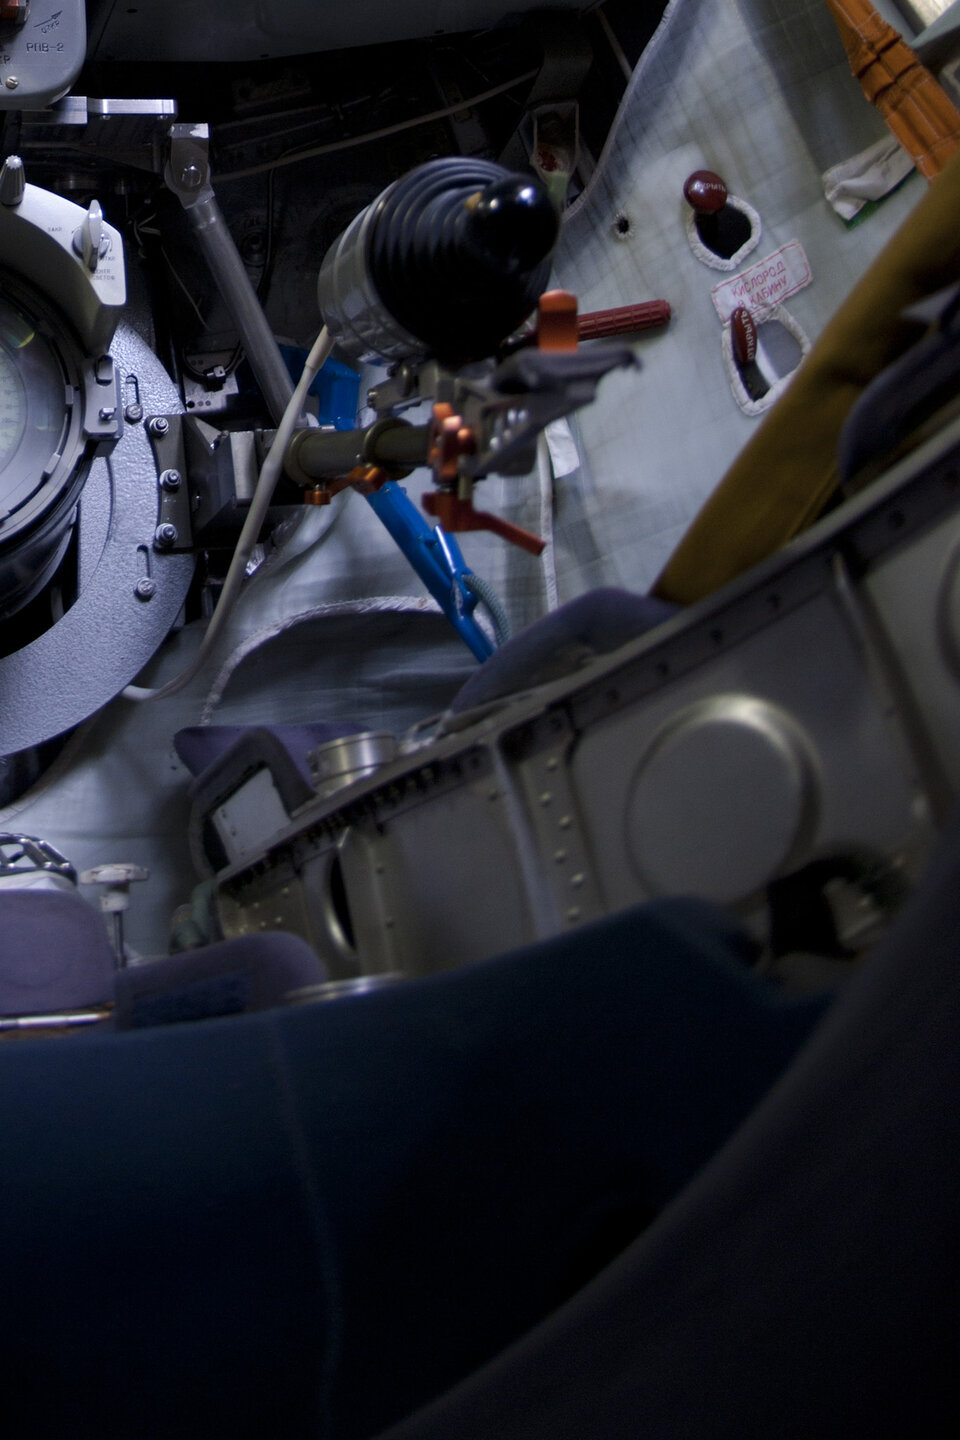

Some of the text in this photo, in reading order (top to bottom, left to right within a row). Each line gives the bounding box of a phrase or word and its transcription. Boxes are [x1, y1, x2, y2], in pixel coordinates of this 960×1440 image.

[26, 42, 65, 52] РПВ-2
[732, 260, 786, 297] КИСЛОРОД
[751, 275, 787, 306] КАБИНУ
[740, 310, 754, 360] ОТКРЫТЬ
